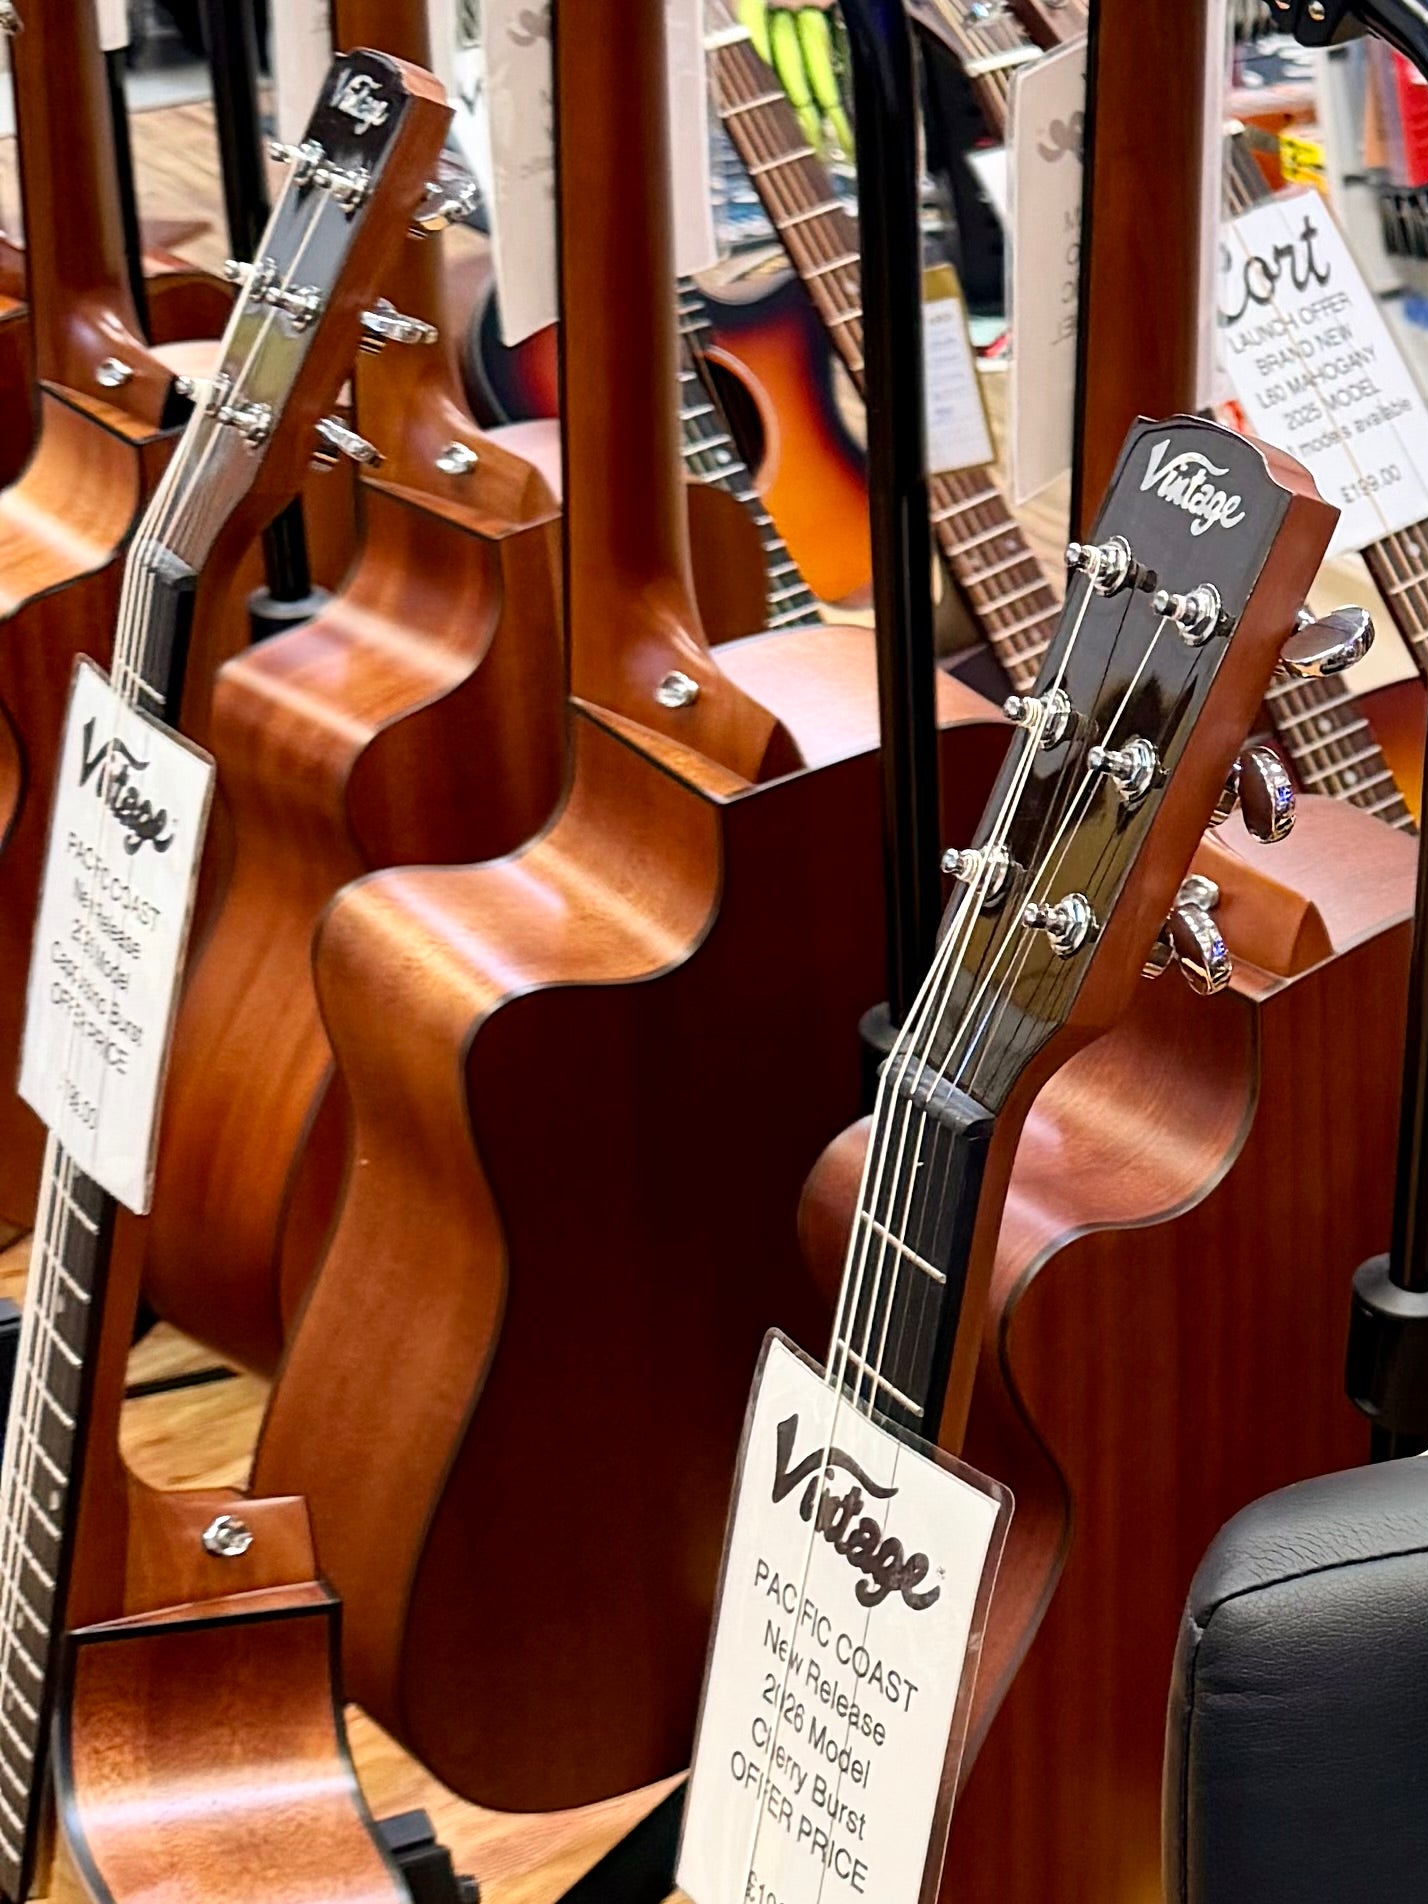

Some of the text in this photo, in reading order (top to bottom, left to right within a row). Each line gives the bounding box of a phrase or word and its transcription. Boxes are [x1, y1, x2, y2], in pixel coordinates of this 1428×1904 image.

[1228, 291, 1352, 355] LAUNCH OFFER
[1254, 323, 1353, 377] BRAND NEW
[1287, 344, 1378, 398] MAHOGANY
[1324, 377, 1382, 412] MODEL
[1139, 438, 1246, 536] Vintage
[771, 1413, 943, 1611] Vintage
[753, 1557, 919, 1713] PACFIC COAST
[763, 1618, 886, 1747] New Release
[808, 1715, 872, 1789] Model
[810, 1773, 867, 1841] Burst
[797, 1814, 869, 1894] PRICE
